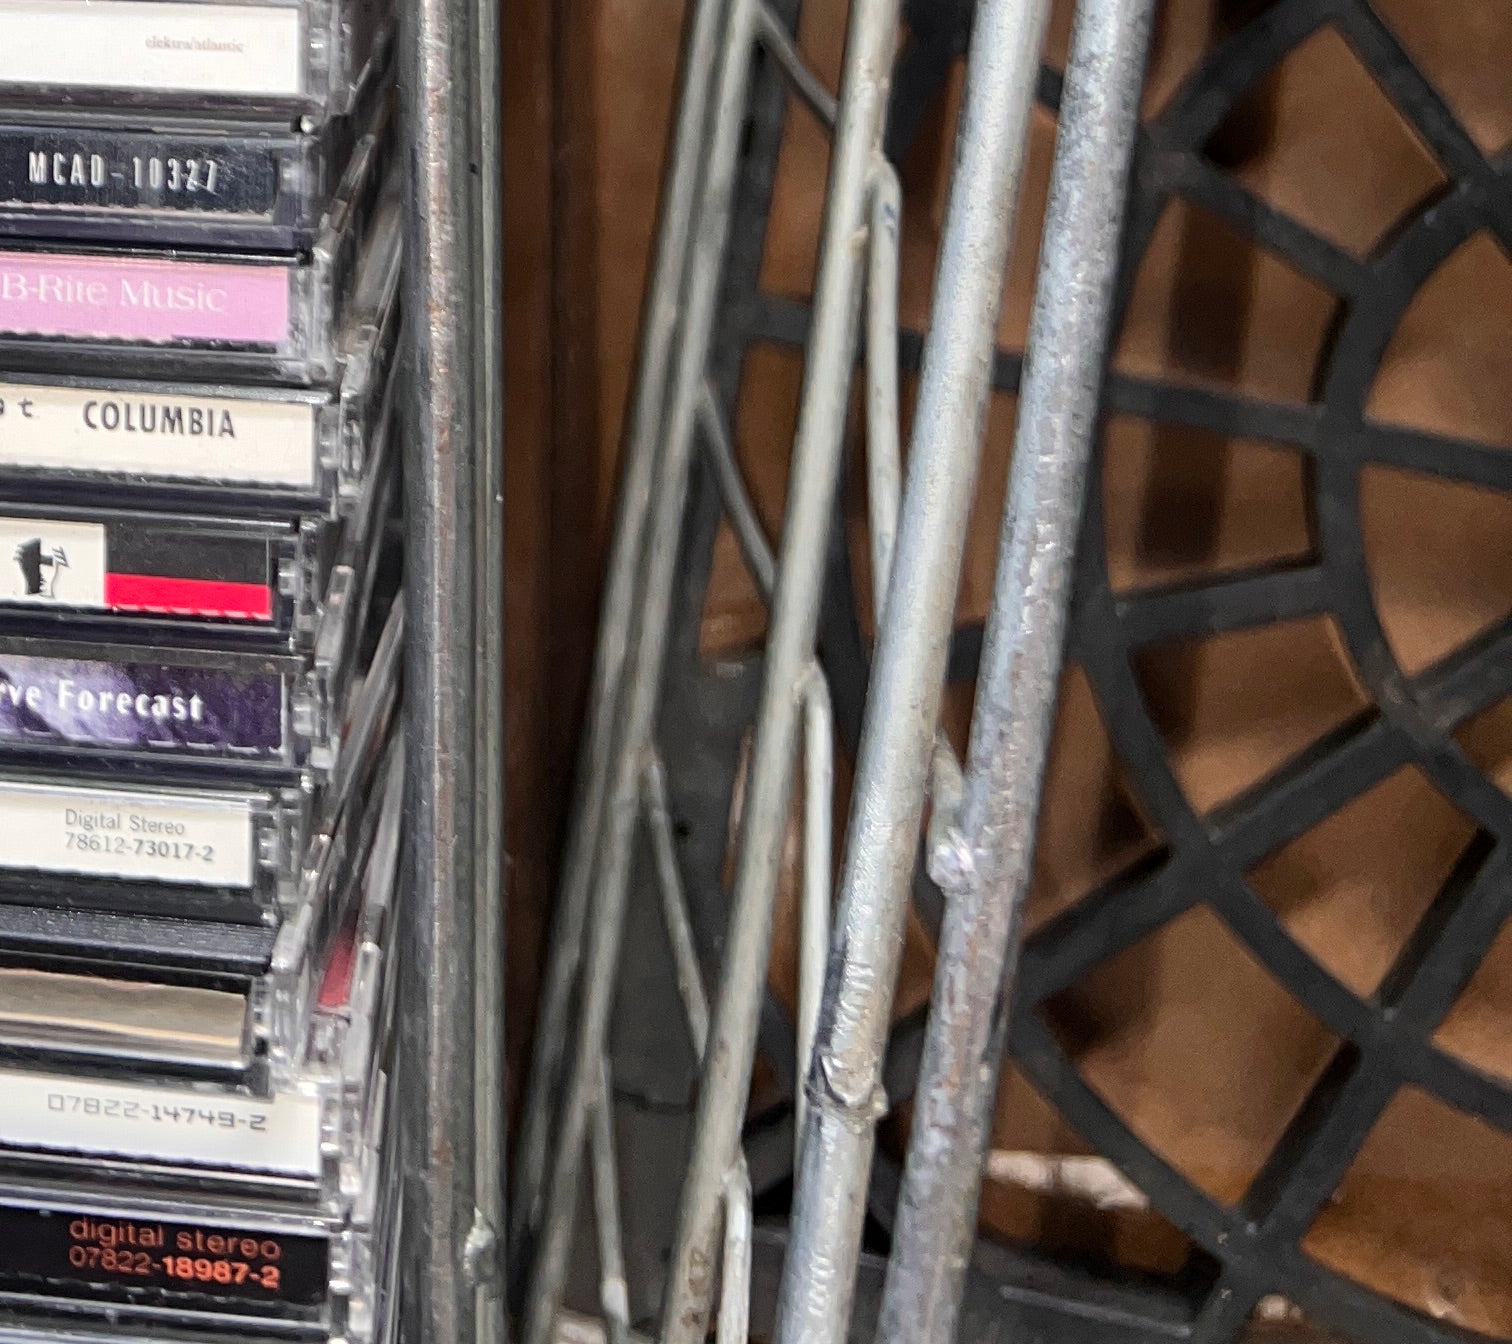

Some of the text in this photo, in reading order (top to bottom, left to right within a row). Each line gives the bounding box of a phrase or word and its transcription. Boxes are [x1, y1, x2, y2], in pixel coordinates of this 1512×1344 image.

[120, 279, 227, 313] Music
[82, 401, 236, 440] COLUMBIA
[57, 679, 204, 721] Forecast
[64, 809, 186, 836] Digital Stereo
[69, 1216, 281, 1260] digital stereo
[69, 1245, 280, 1290] 07822-18987-2
